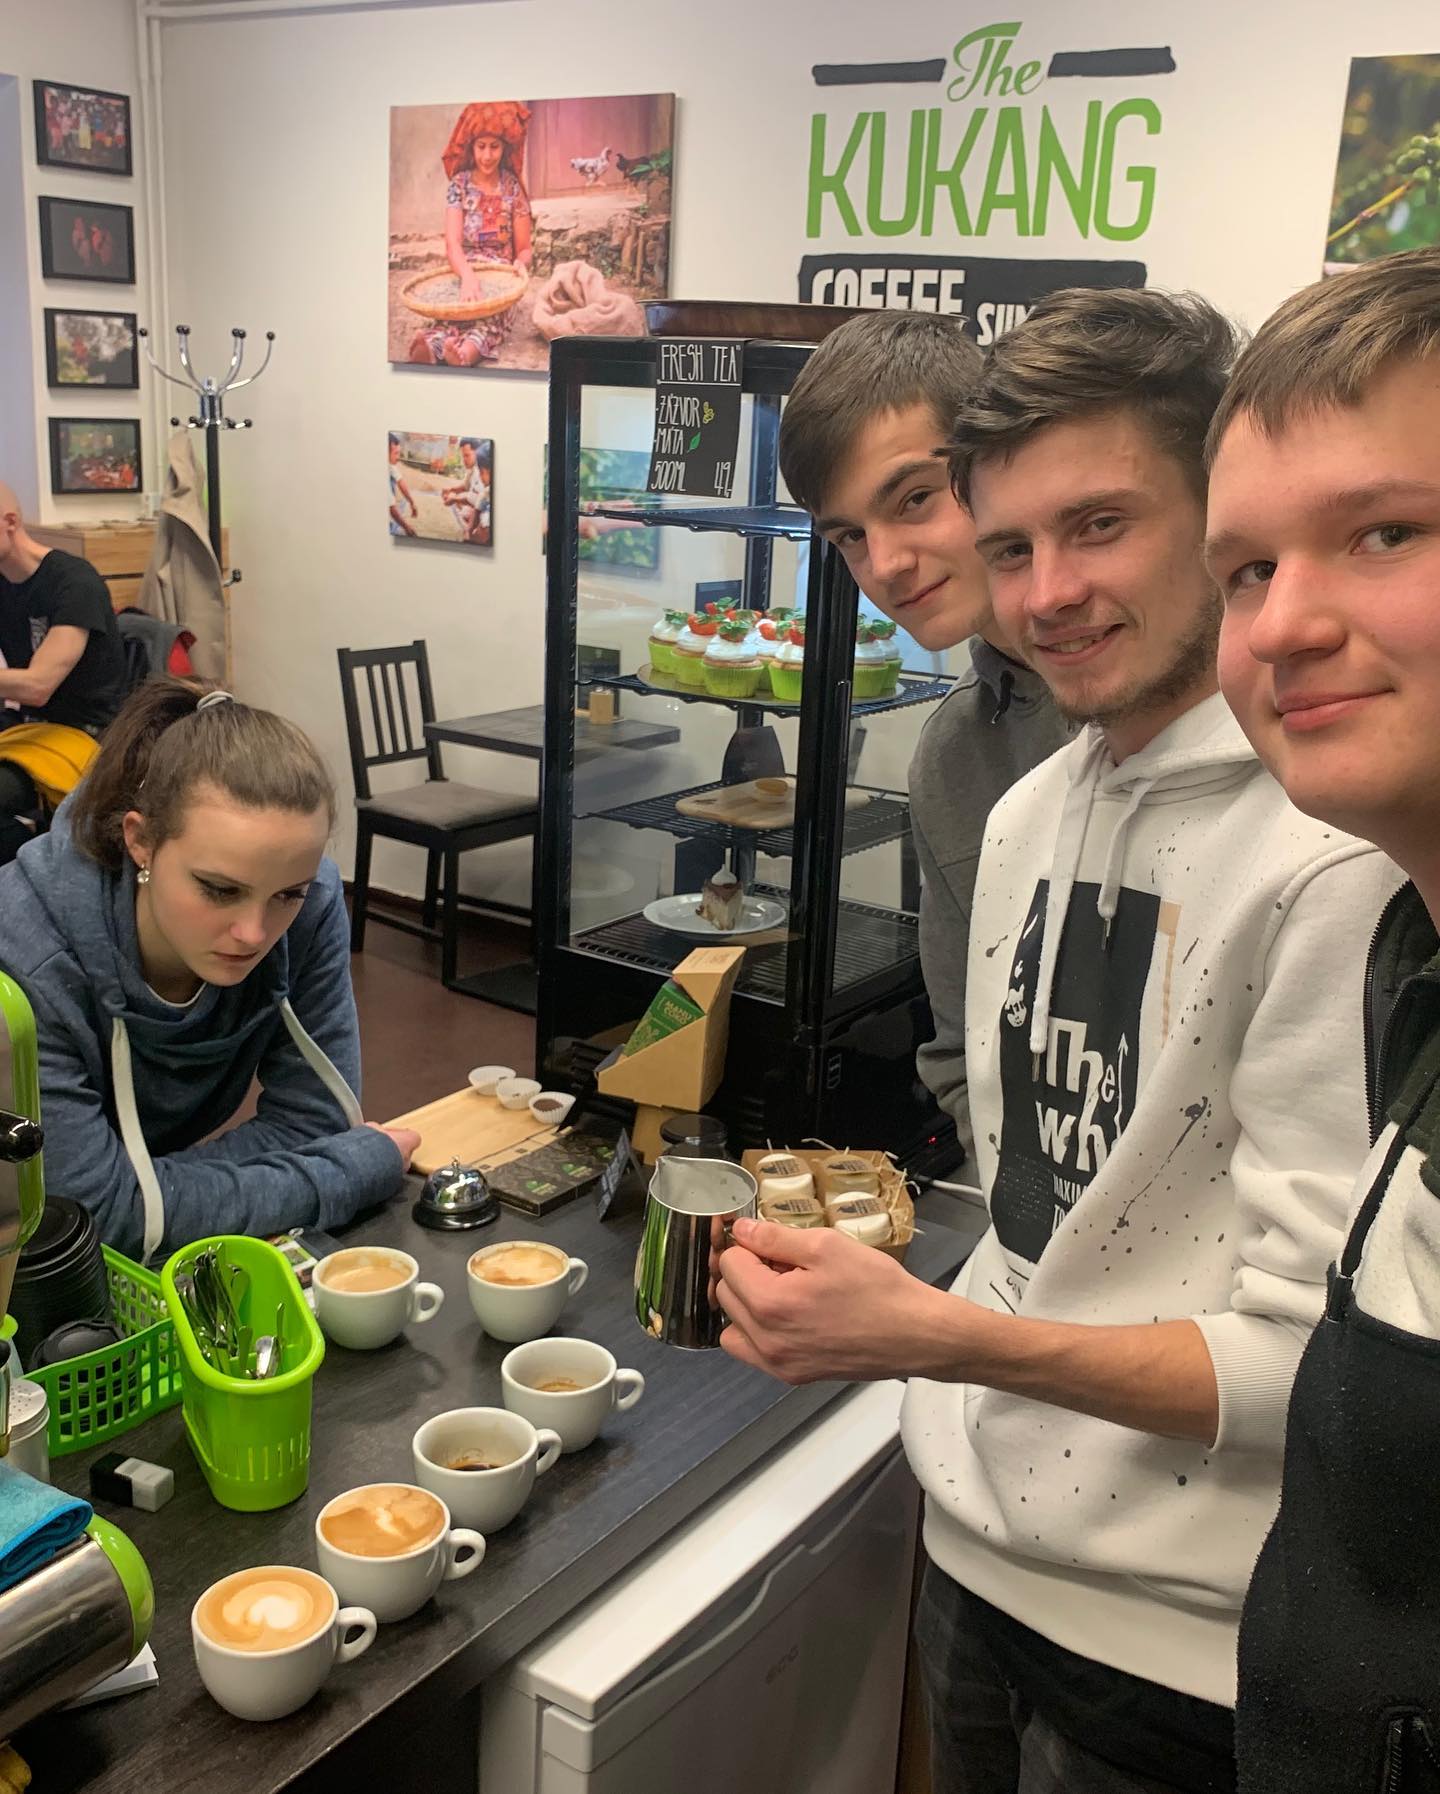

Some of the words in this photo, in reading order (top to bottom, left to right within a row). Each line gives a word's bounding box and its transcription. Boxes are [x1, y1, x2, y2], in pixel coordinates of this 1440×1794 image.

[947, 21, 1047, 102] The
[806, 97, 1161, 242] KUKANG
[811, 268, 965, 314] COFFEE
[661, 344, 703, 381] FRESH
[711, 345, 737, 382] TEA
[1035, 1100, 1108, 1173] wh
[1053, 1173, 1088, 1204] MAXIM
